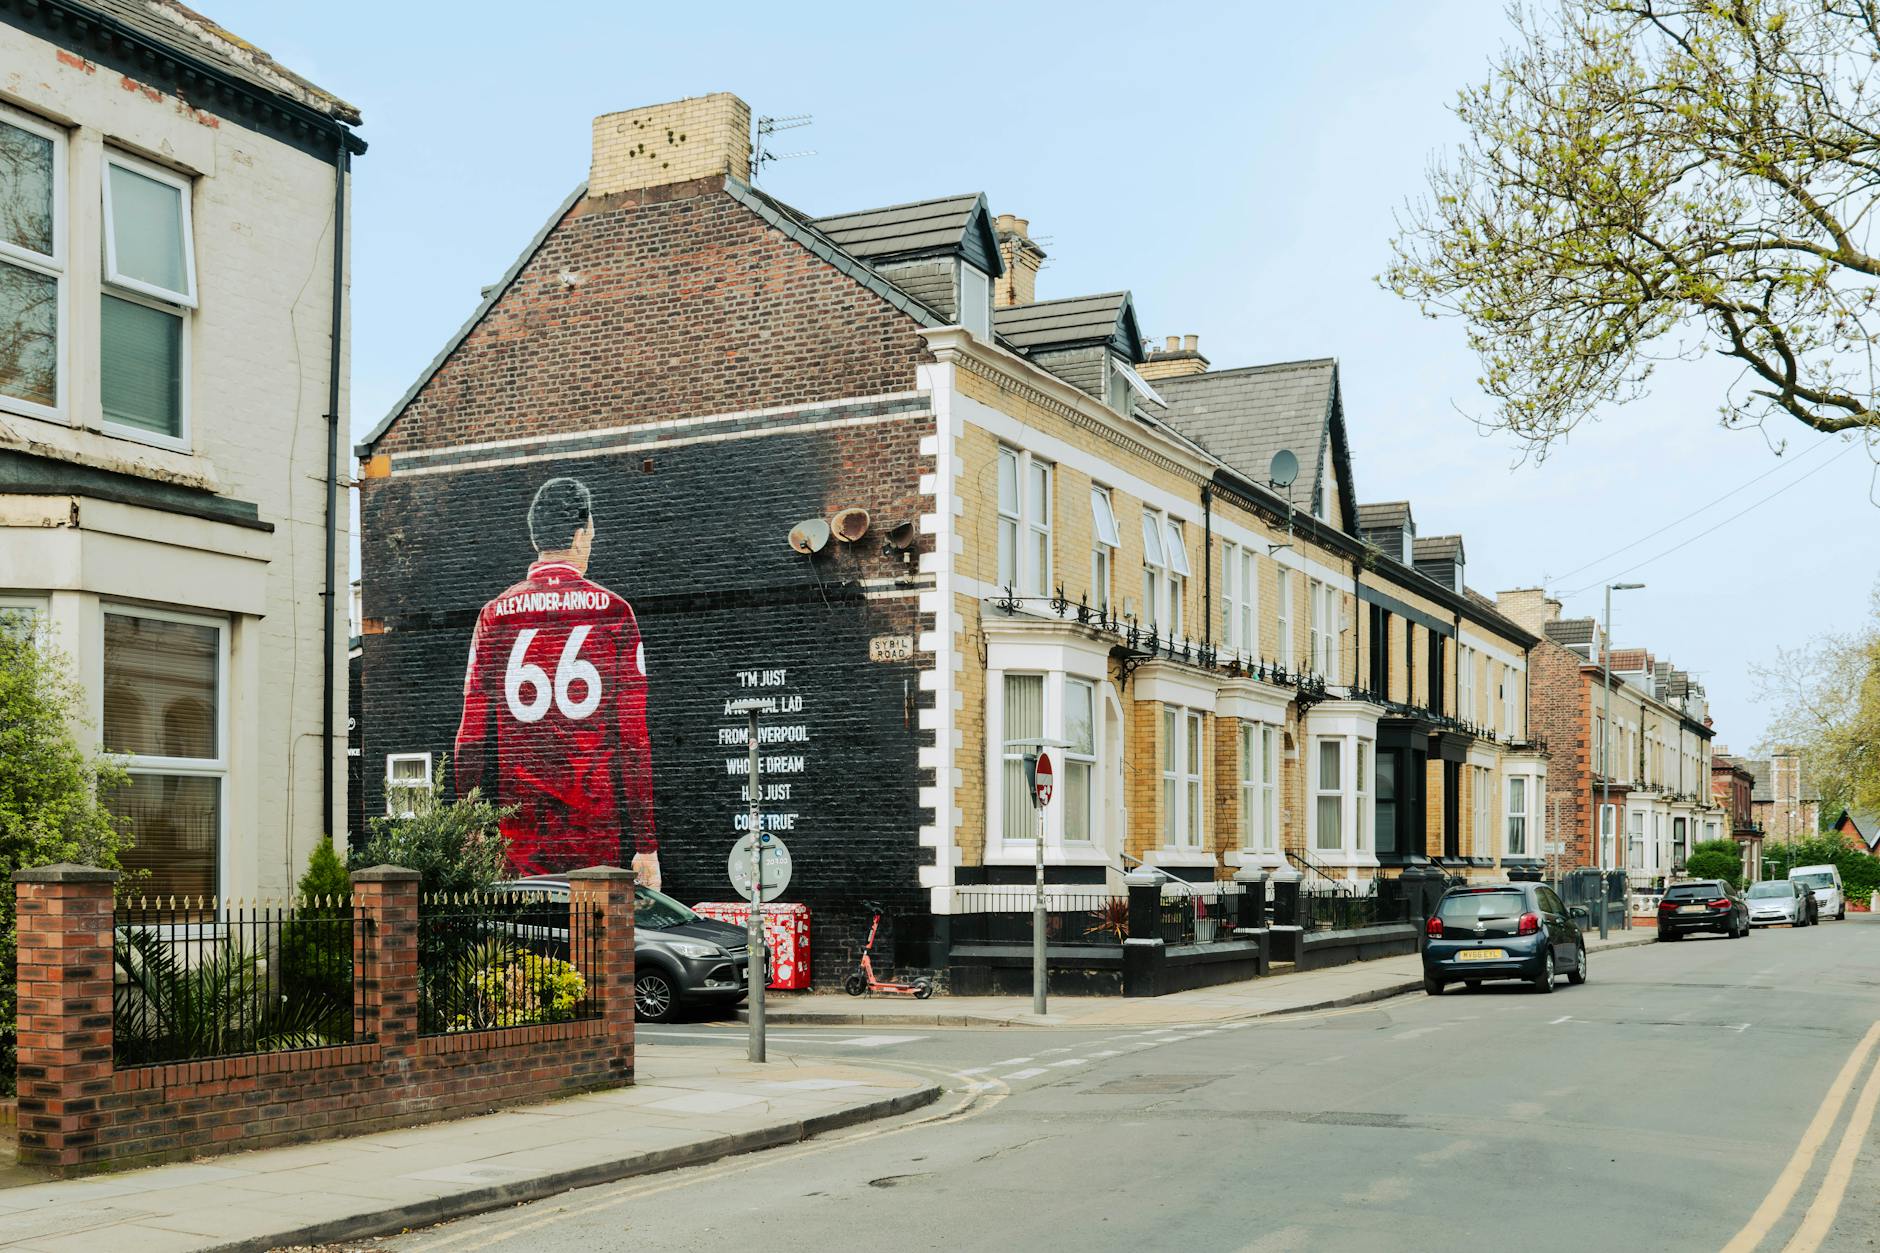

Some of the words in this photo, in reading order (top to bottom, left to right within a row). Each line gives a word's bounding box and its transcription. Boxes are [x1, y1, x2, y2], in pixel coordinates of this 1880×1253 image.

[495, 590, 610, 617] ALEXANDER-ARNOLD
[877, 650, 905, 659] ROAD
[504, 624, 602, 723] 66
[760, 670, 786, 686] JUST
[724, 699, 732, 715] A
[782, 696, 803, 713] LAD
[718, 727, 749, 744] FROM
[757, 725, 810, 744] IVERPOOL
[725, 757, 765, 775] WHOE
[766, 755, 805, 773] DREAM
[741, 784, 763, 801] HS
[764, 783, 791, 800] JUST
[734, 813, 765, 830] COE
